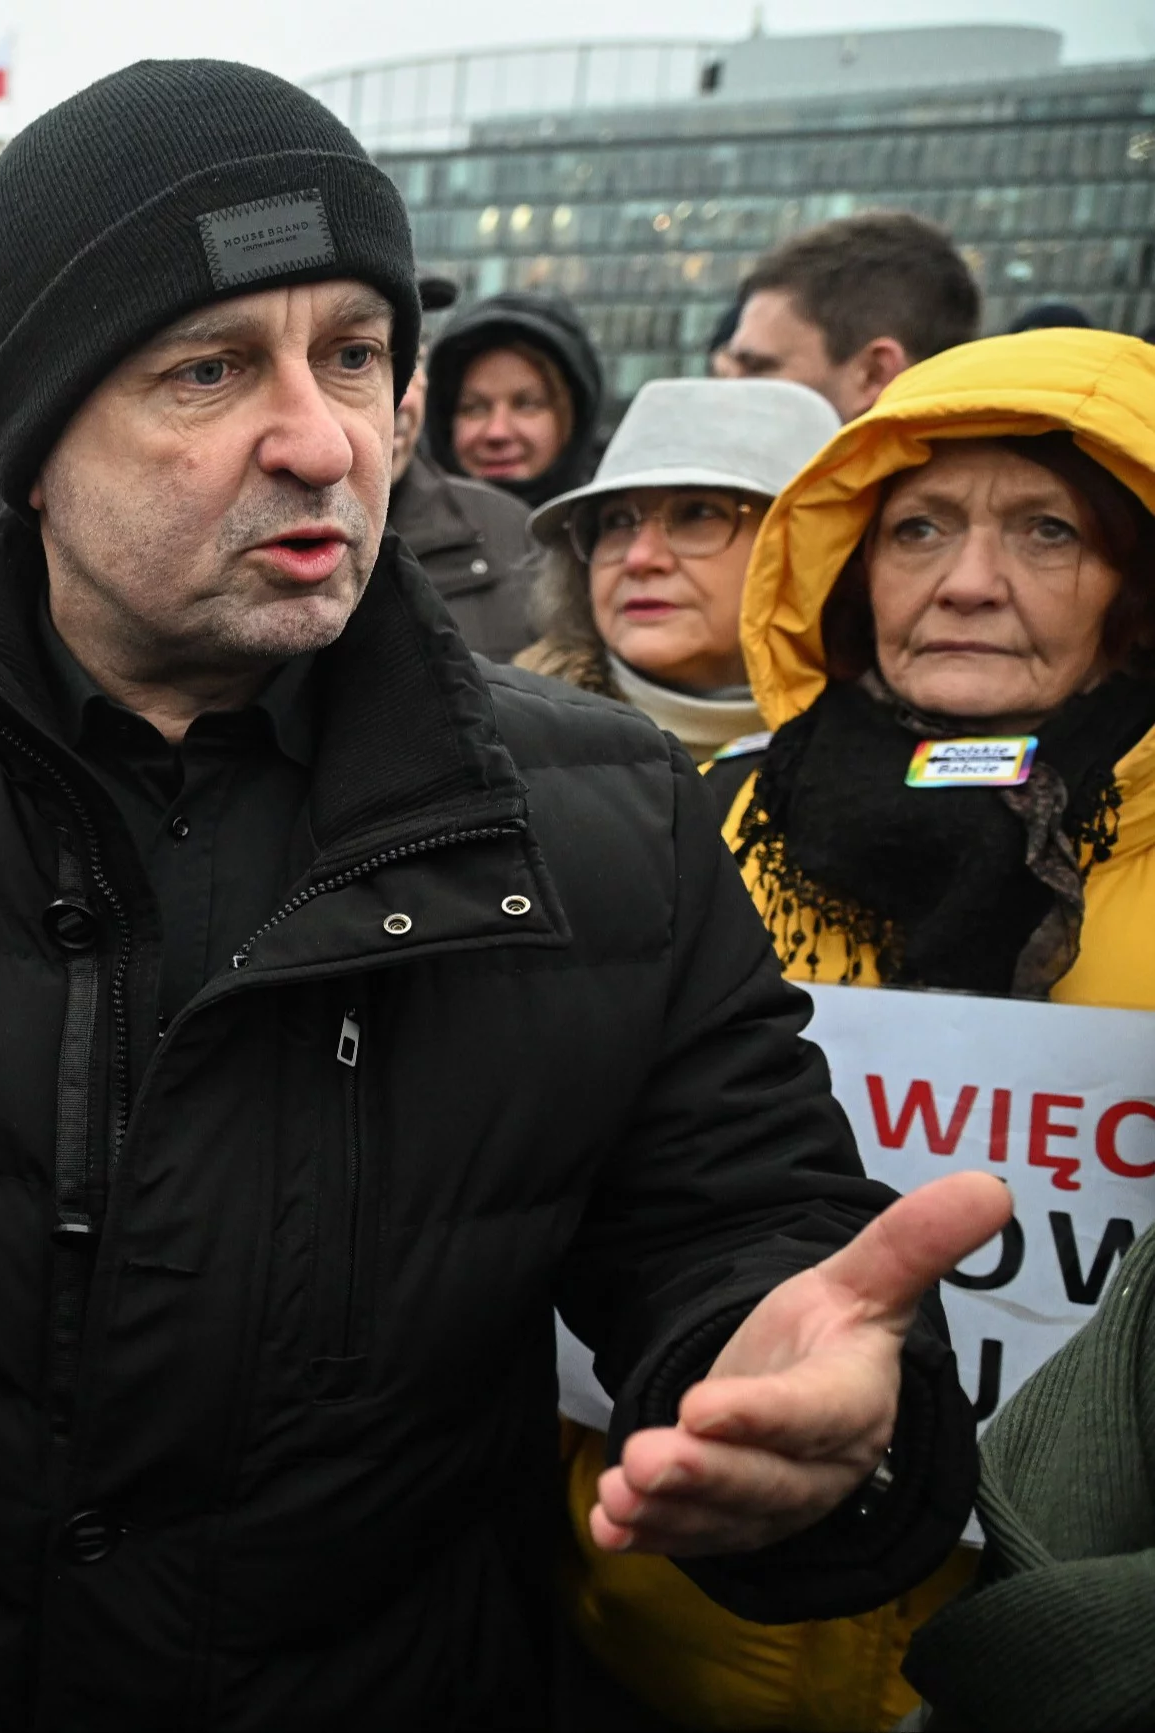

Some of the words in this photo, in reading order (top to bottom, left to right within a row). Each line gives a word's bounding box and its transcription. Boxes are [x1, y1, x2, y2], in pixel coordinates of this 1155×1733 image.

[268, 222, 309, 237] BRAND
[943, 745, 1010, 757] Polskie
[937, 764, 1000, 774] Babcie
